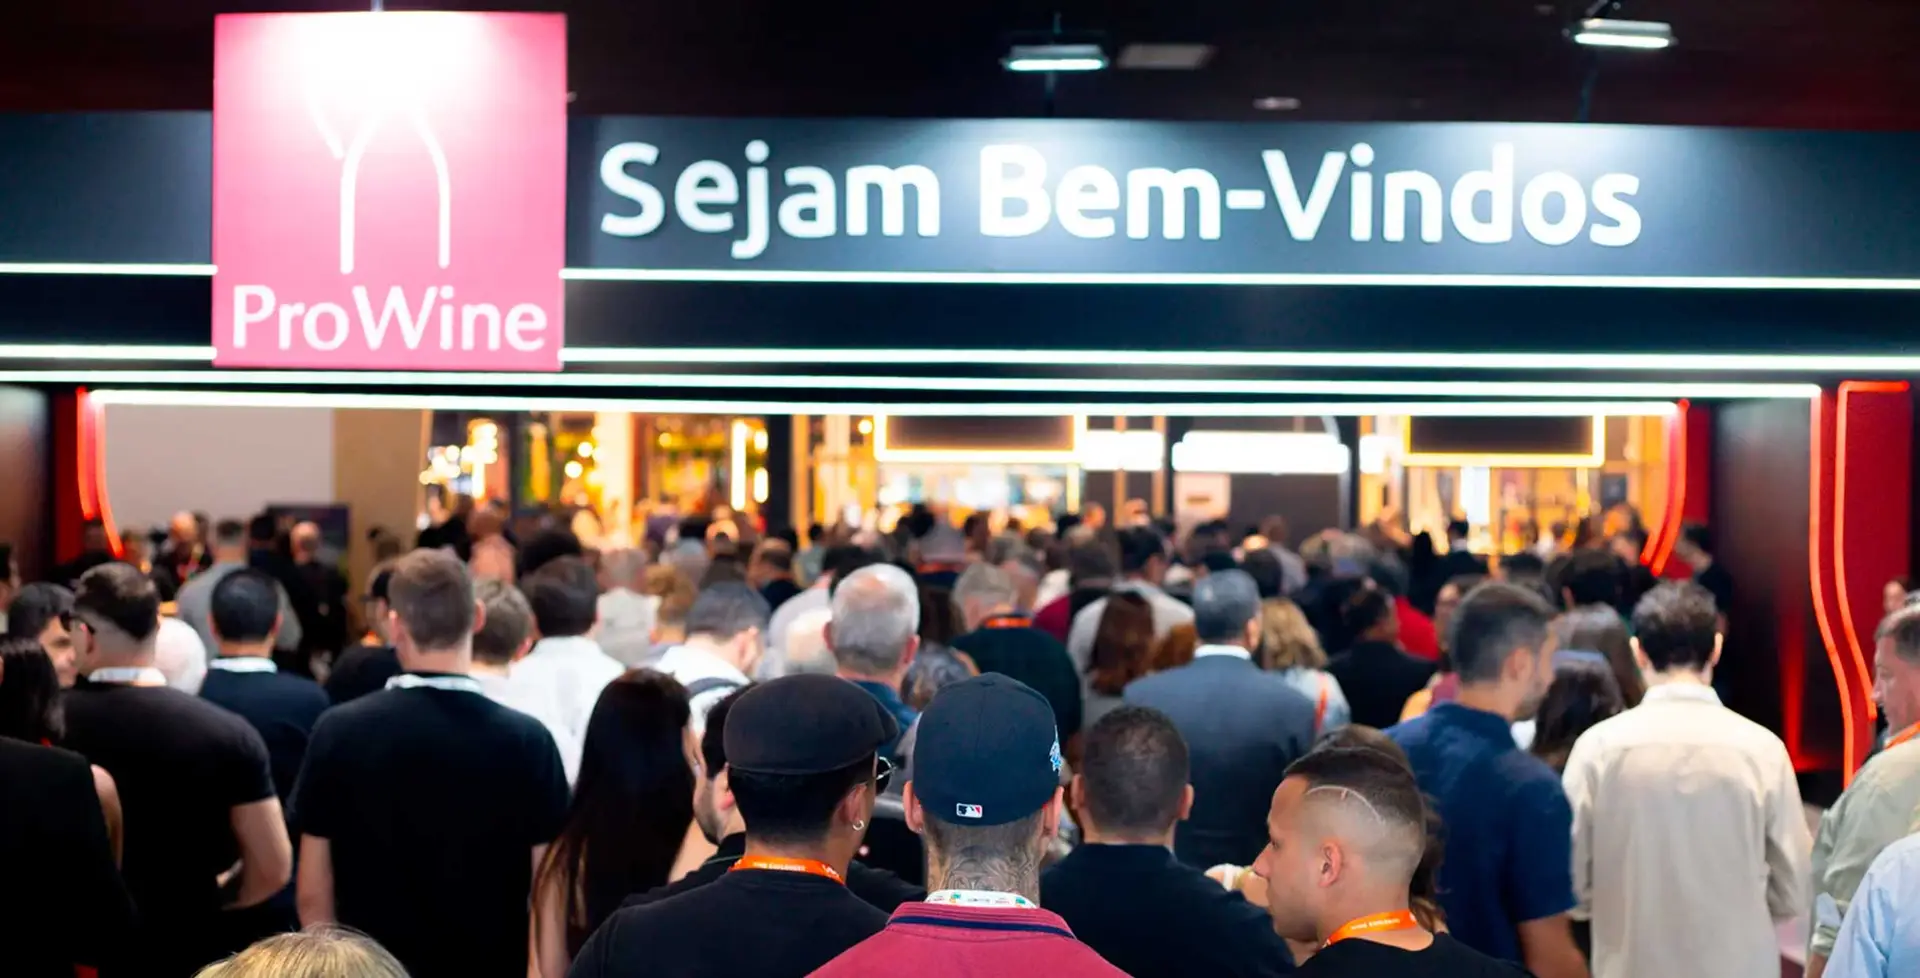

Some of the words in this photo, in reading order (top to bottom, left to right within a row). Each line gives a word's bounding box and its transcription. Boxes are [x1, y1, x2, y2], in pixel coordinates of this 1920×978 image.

[600, 139, 940, 259] Sejam
[979, 142, 1642, 247] Bem-Vindos
[233, 284, 548, 351] ProWine
